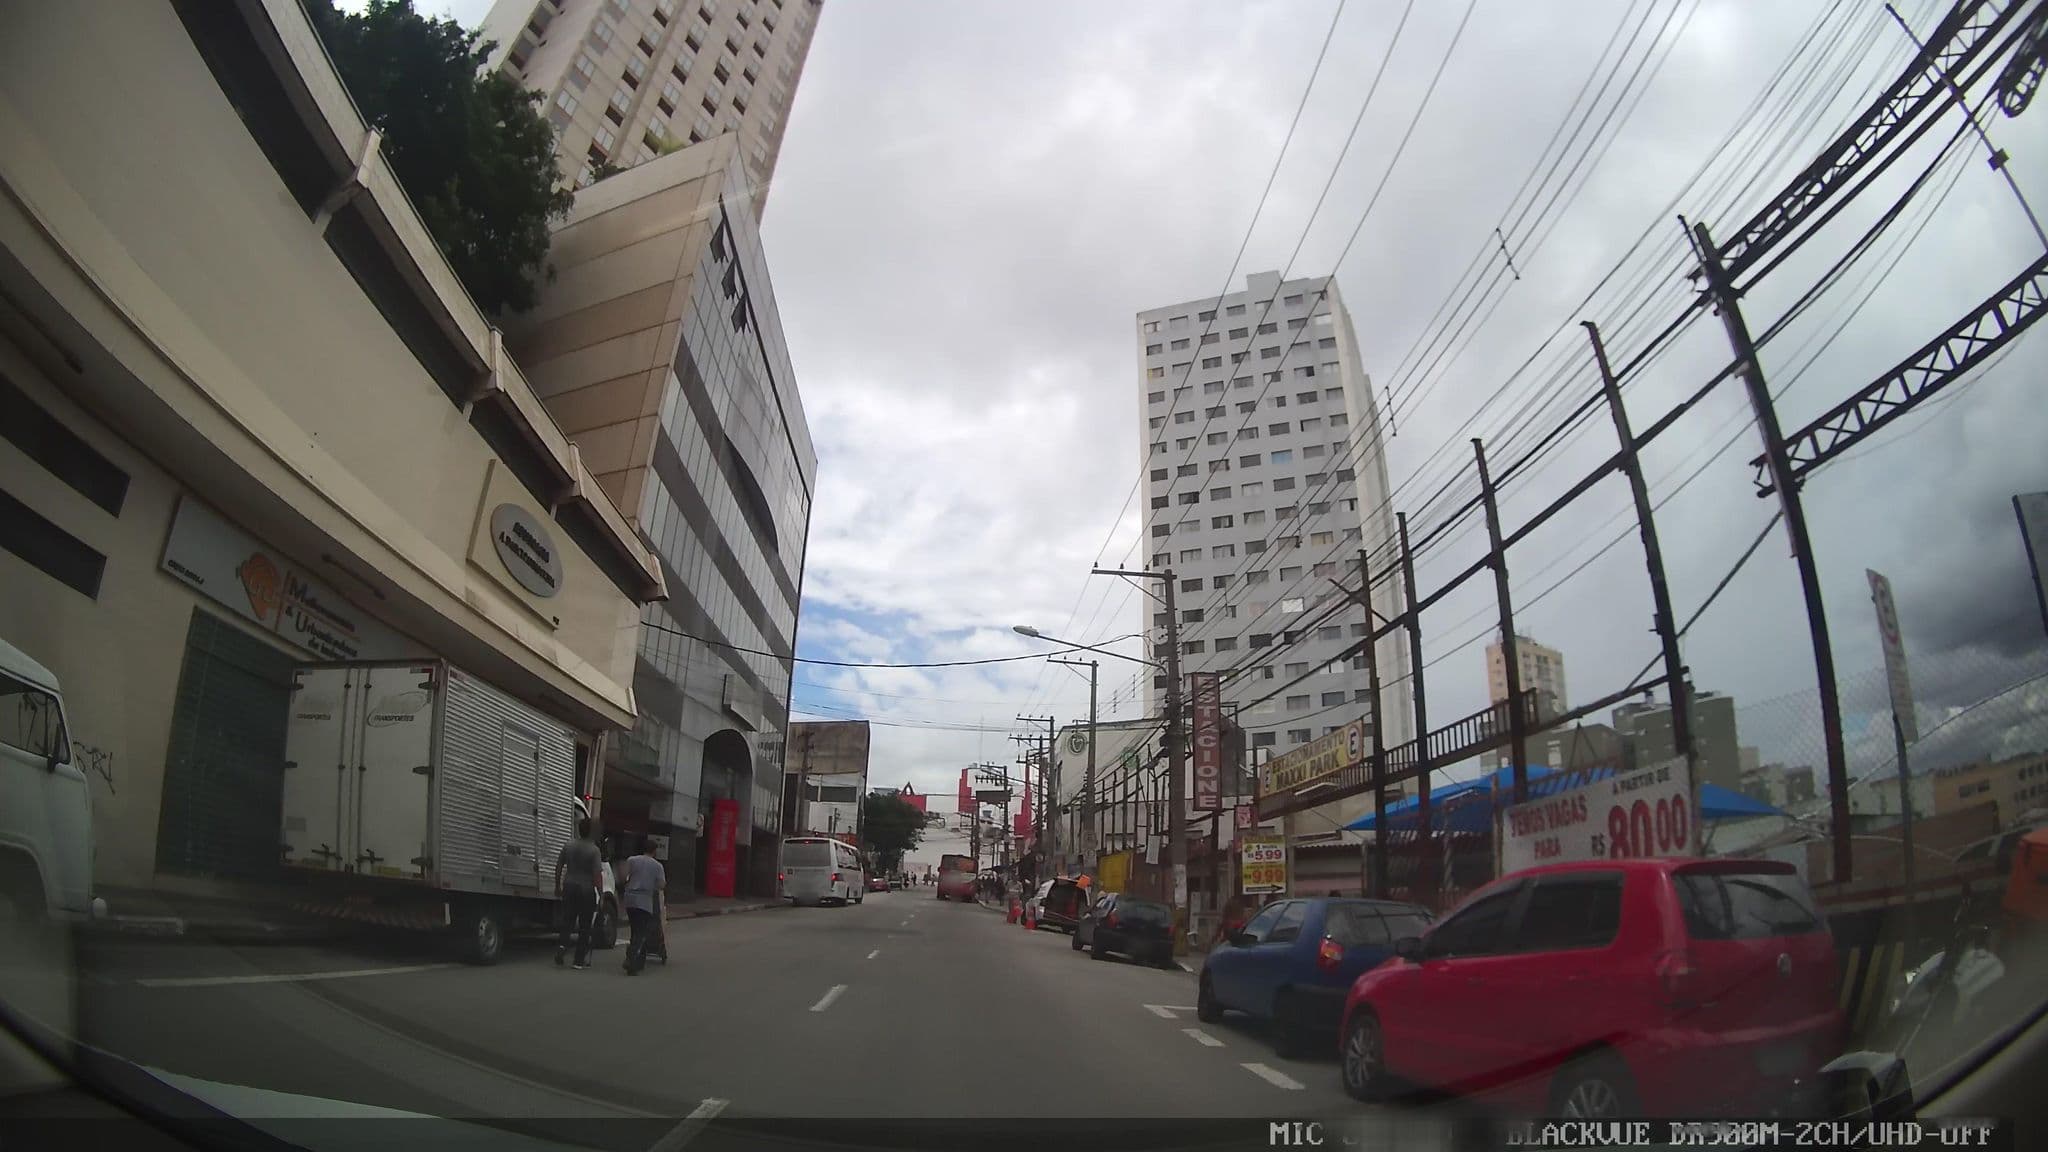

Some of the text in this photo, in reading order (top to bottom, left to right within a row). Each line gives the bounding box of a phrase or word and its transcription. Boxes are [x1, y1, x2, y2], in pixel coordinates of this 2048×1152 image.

[1196, 674, 1219, 809] ESTACIONE
[1272, 730, 1346, 774] ESTACIONAMENTO
[1309, 749, 1340, 777] PARK
[1546, 793, 1588, 829] VAGAS
